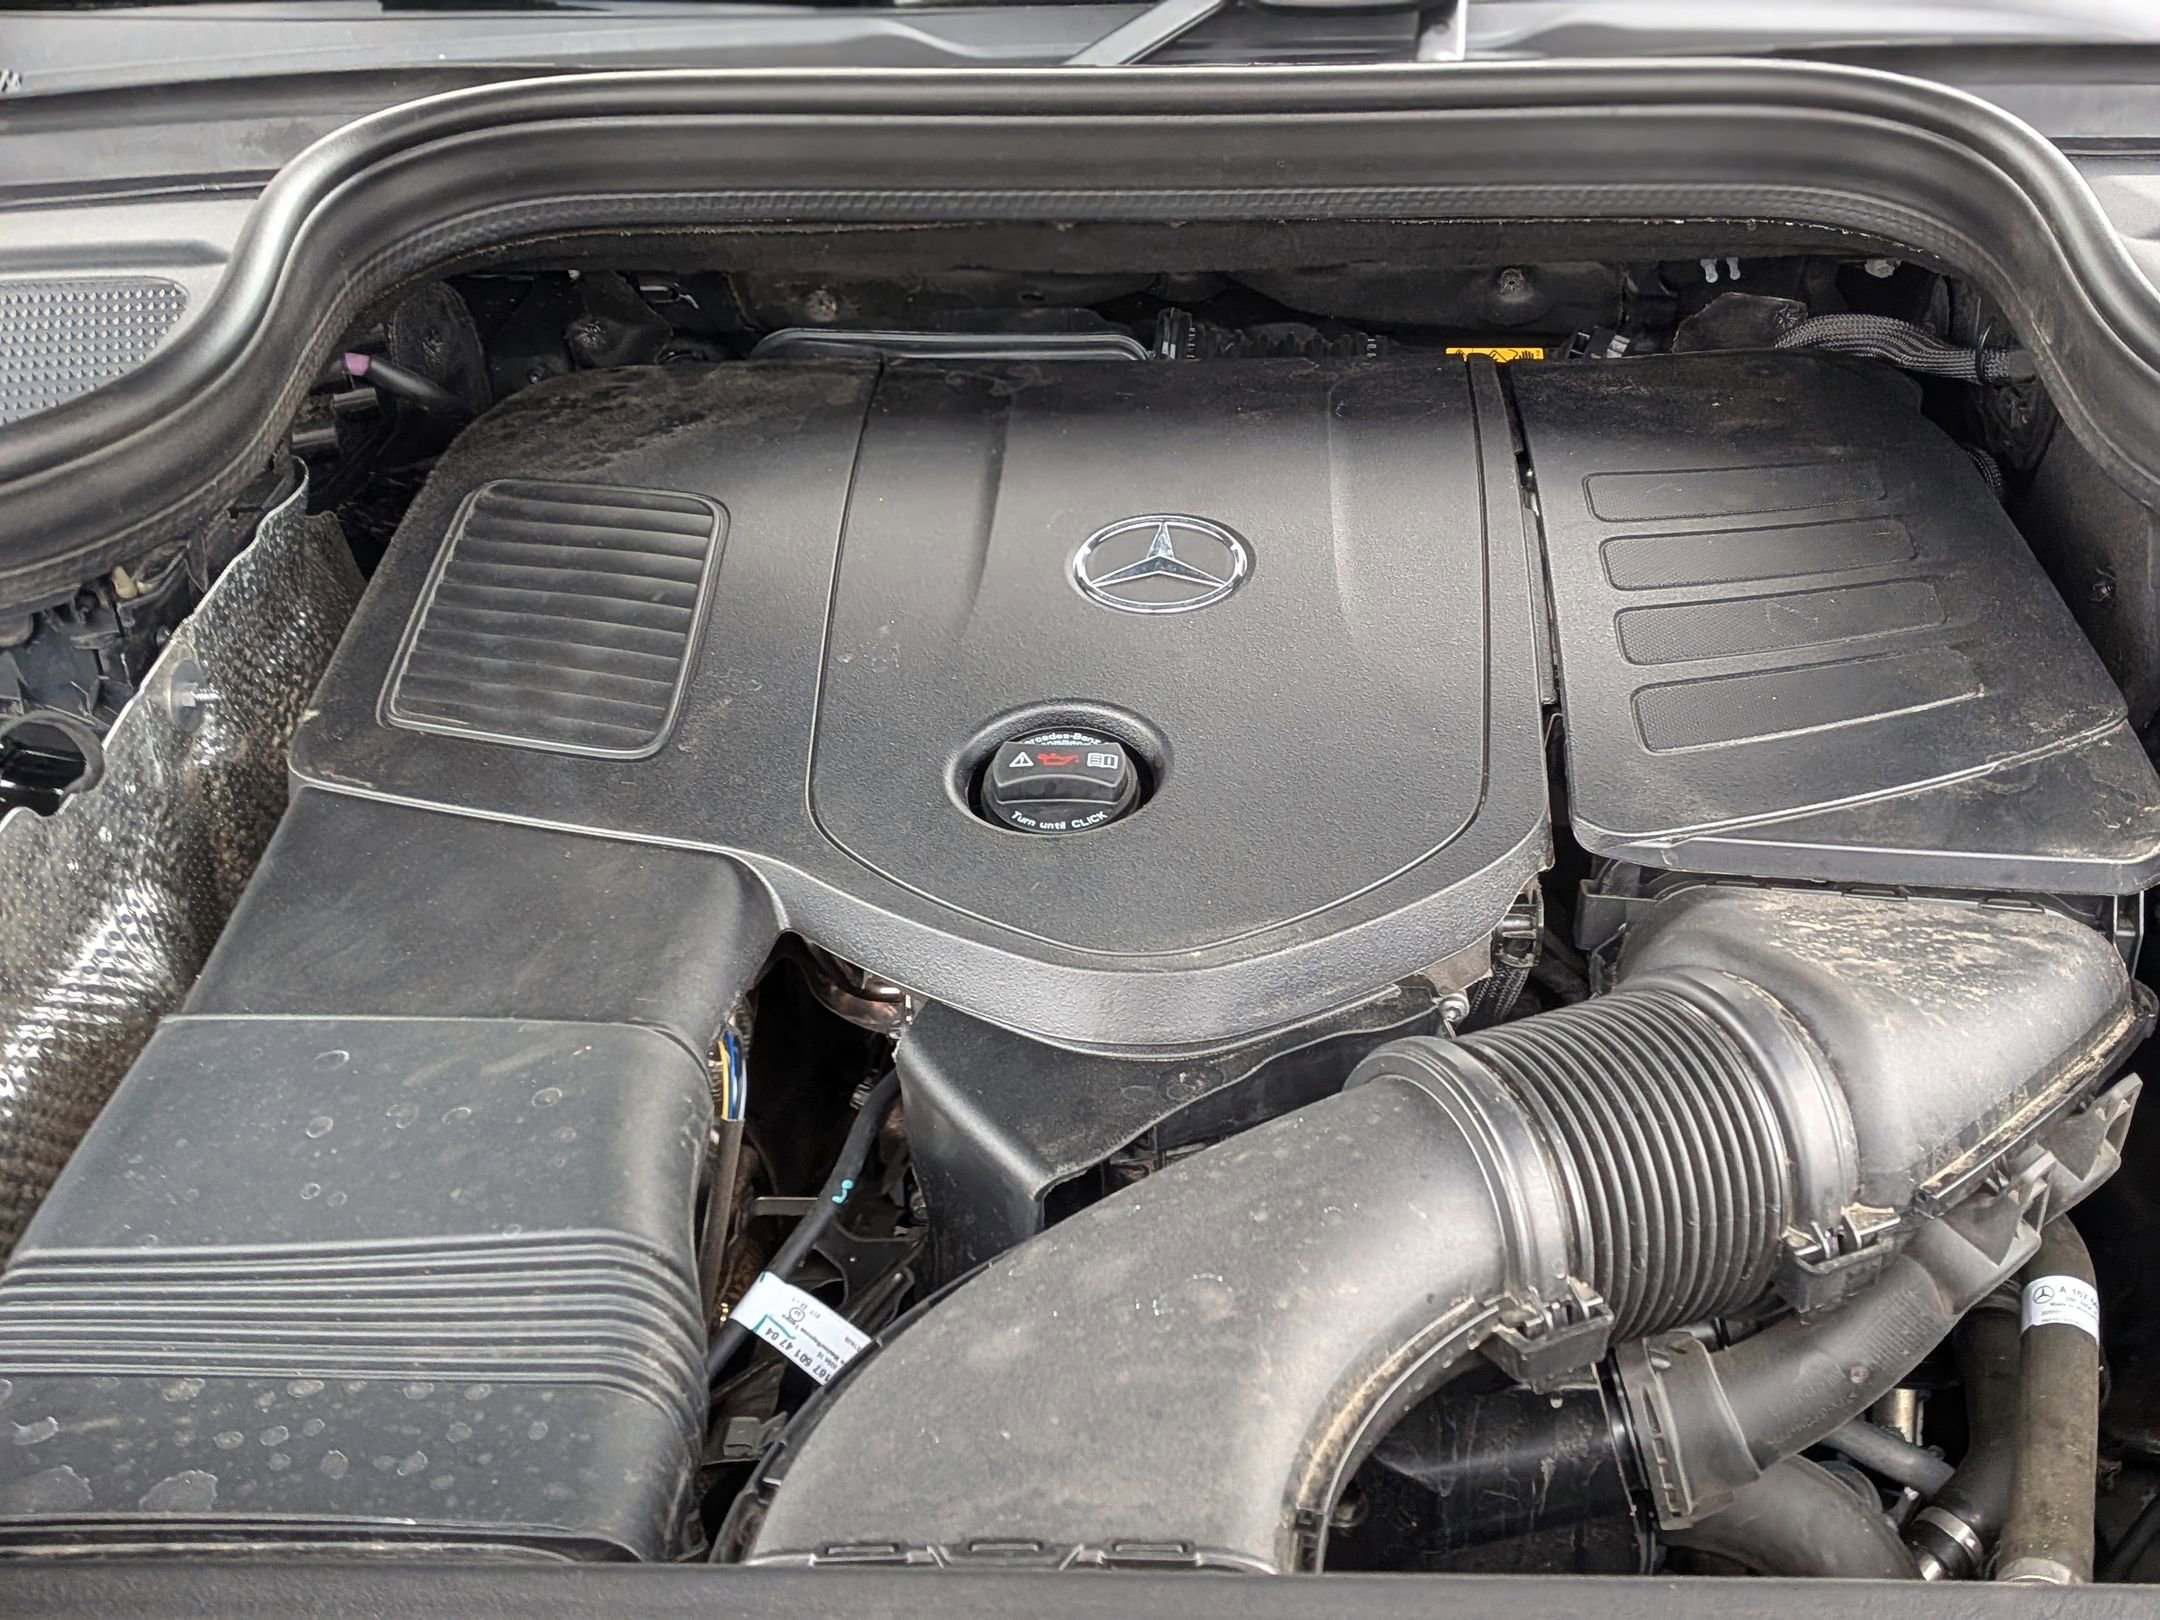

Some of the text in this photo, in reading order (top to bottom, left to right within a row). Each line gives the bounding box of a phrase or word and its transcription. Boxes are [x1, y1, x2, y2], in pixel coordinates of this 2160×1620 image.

[1011, 810, 1108, 830] Turn until CLICK
